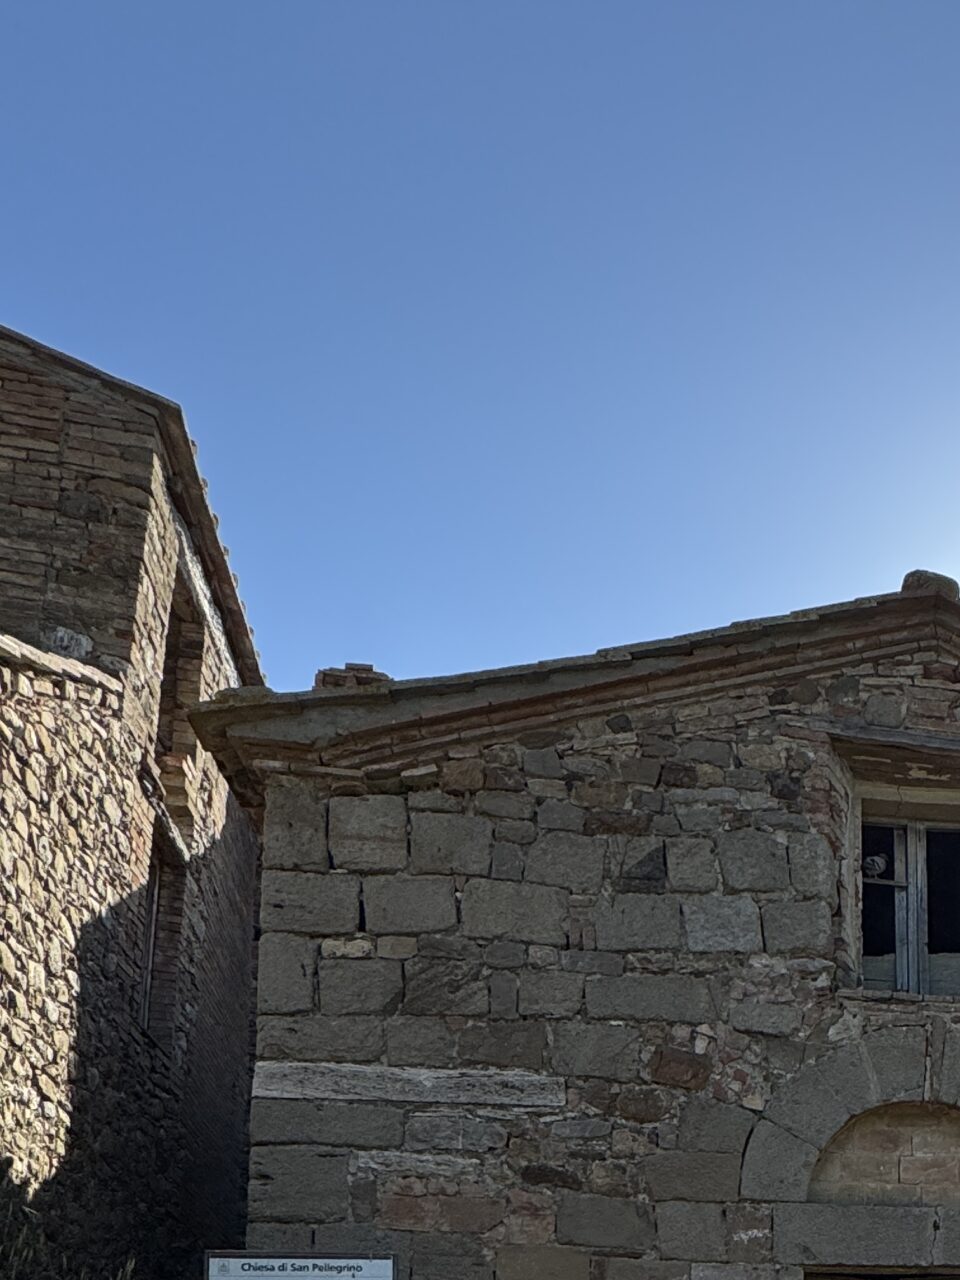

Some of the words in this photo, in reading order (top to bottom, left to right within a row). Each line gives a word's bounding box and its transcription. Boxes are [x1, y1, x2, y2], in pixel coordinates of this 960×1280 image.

[241, 1262, 275, 1272] Chiesa
[278, 1262, 288, 1272] di
[291, 1262, 309, 1272] San
[312, 1263, 363, 1274] Pellegrino
